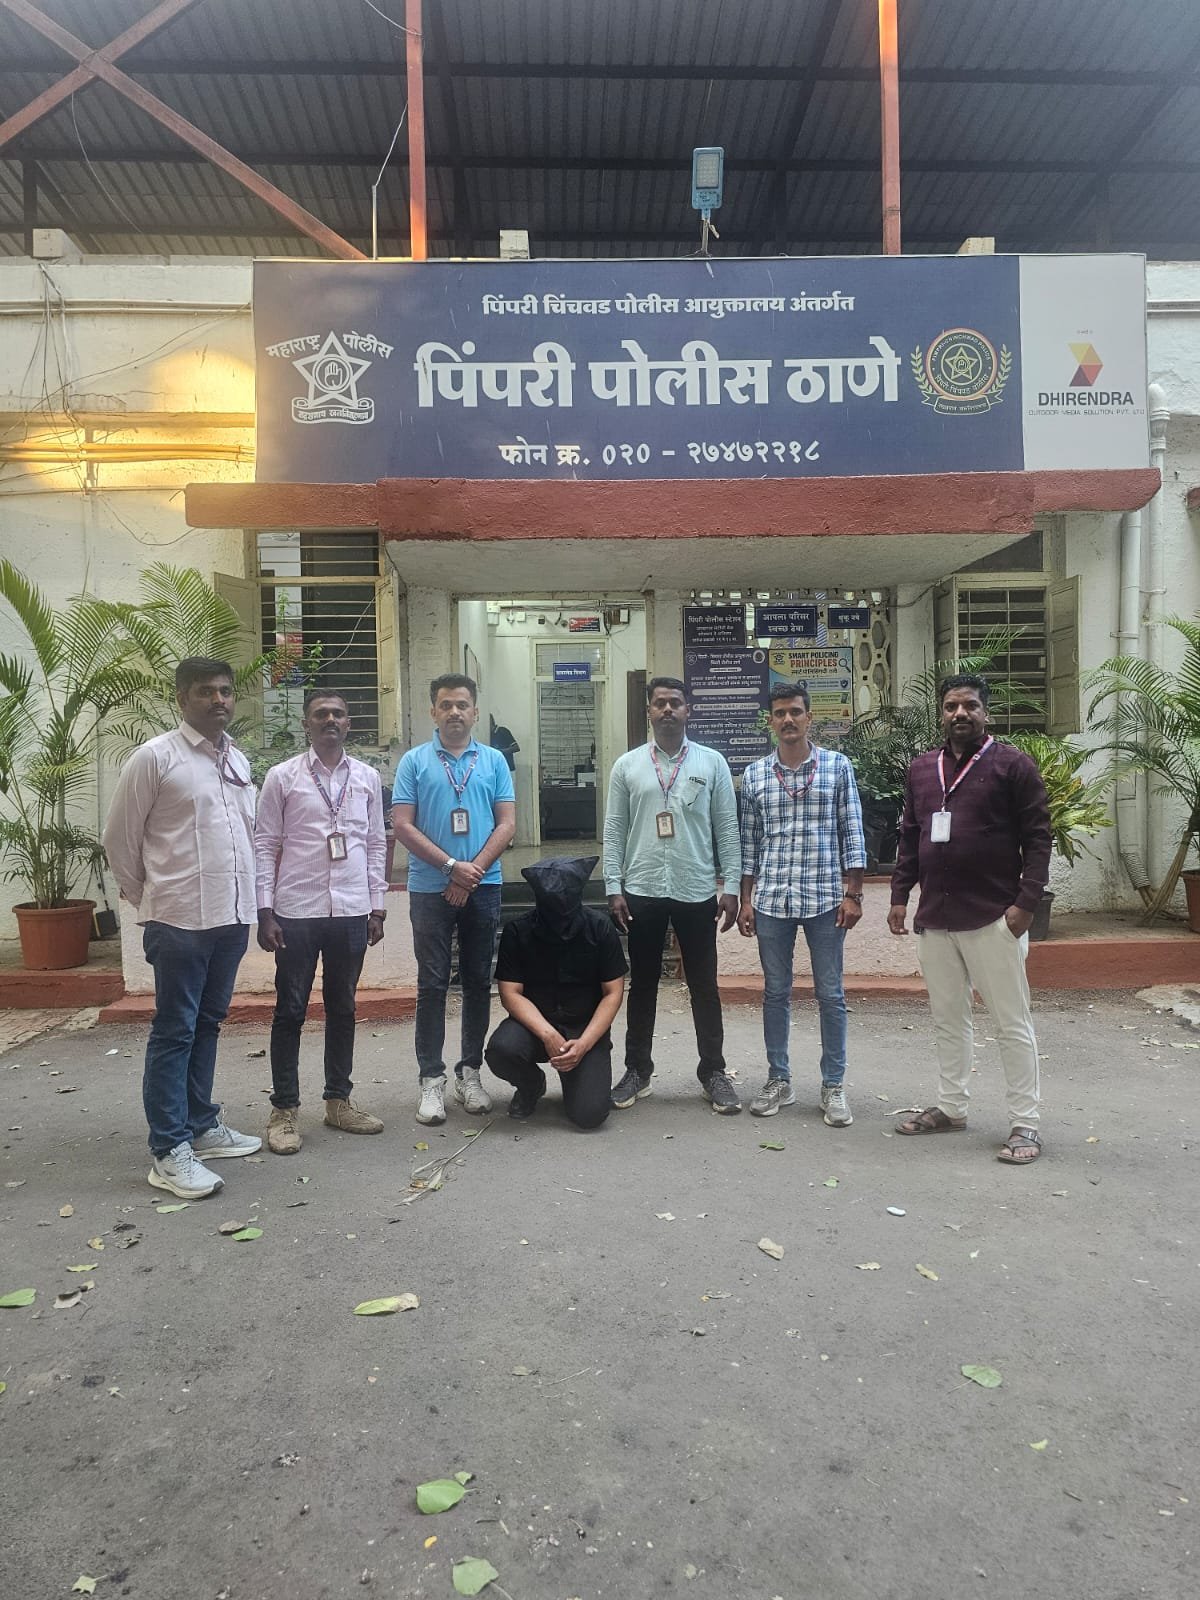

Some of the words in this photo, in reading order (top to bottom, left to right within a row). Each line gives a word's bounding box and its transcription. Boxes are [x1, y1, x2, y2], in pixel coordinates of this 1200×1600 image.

[482, 294, 538, 315] पिंपरी
[543, 293, 611, 315] चिंचवड
[615, 292, 679, 314] पोलीस
[684, 297, 785, 319] आयुक्तालय
[790, 290, 856, 312] अंतर्गत
[265, 334, 321, 358] महाराष्ट्र
[342, 330, 394, 359] पोलीस
[413, 340, 576, 408] पिंपरी
[588, 339, 773, 407] पोलीस
[783, 335, 902, 403] ठाणे
[1038, 391, 1134, 406] DHIRENDRA
[498, 436, 548, 465] फोन
[555, 444, 590, 466] क्र.
[602, 443, 650, 466] ०२०
[687, 440, 820, 464] २७४७२२१८
[763, 613, 786, 621] आपला
[788, 611, 810, 621] परिसर
[790, 659, 838, 668] PRINCIPLES
